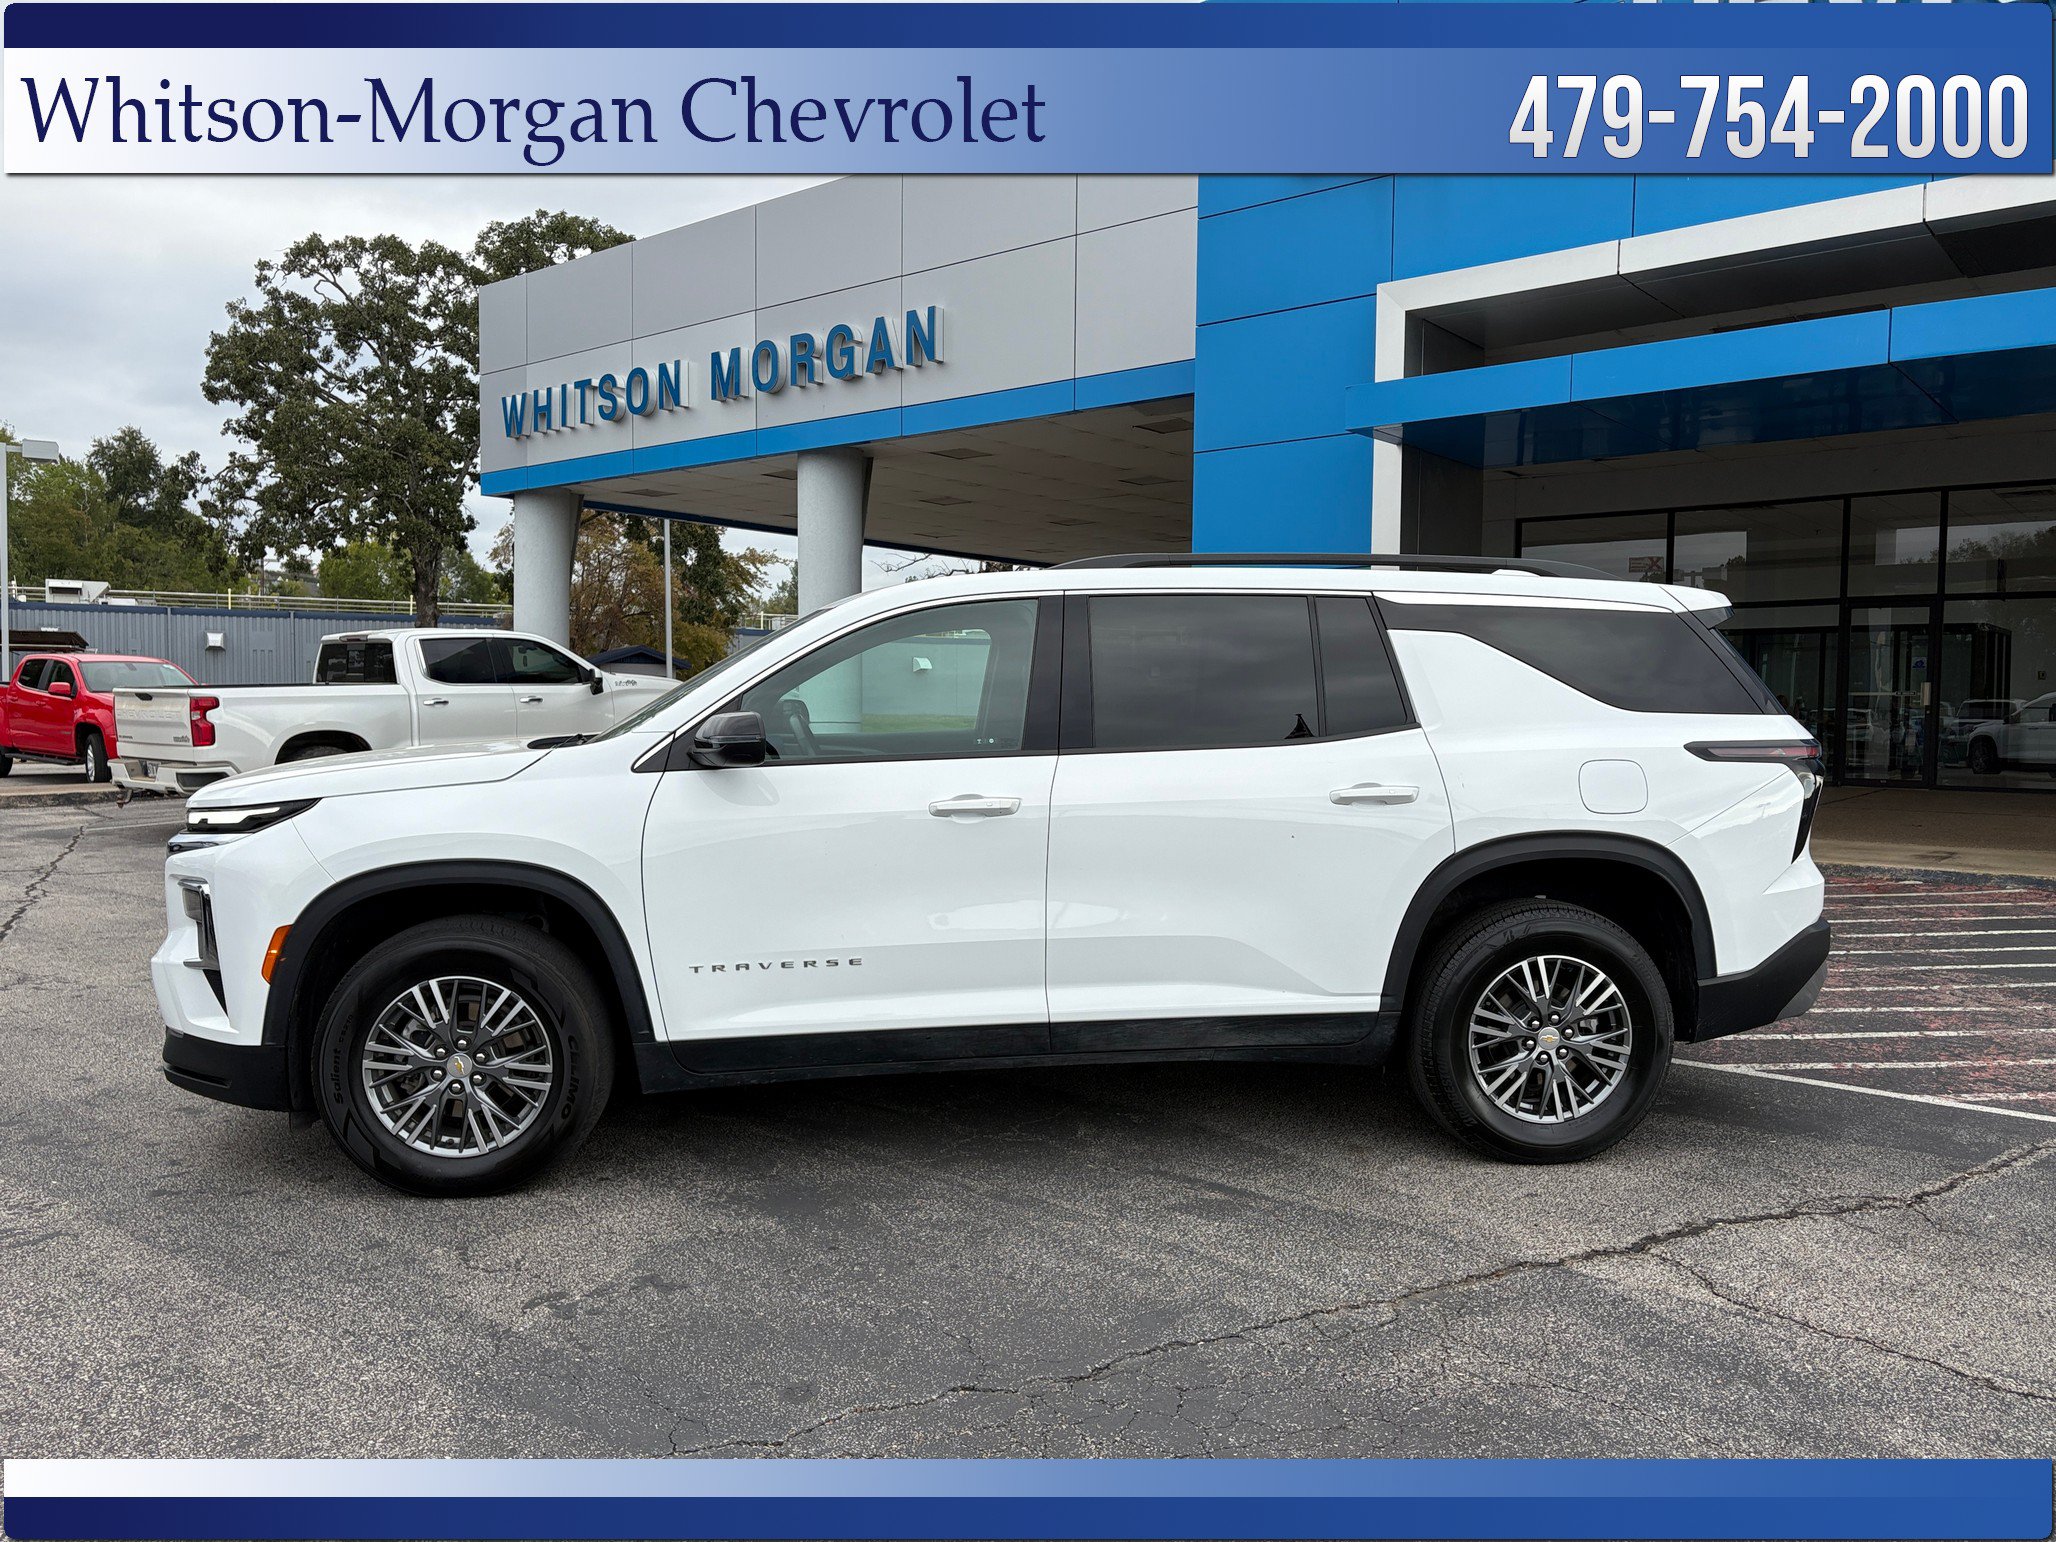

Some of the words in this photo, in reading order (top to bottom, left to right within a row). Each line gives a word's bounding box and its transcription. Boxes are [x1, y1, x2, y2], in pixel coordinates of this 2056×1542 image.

[500, 358, 689, 439] WHITSON
[710, 305, 944, 402] MORGAN
[688, 957, 863, 974] TRAVERSE
[330, 1047, 344, 1105] Salient
